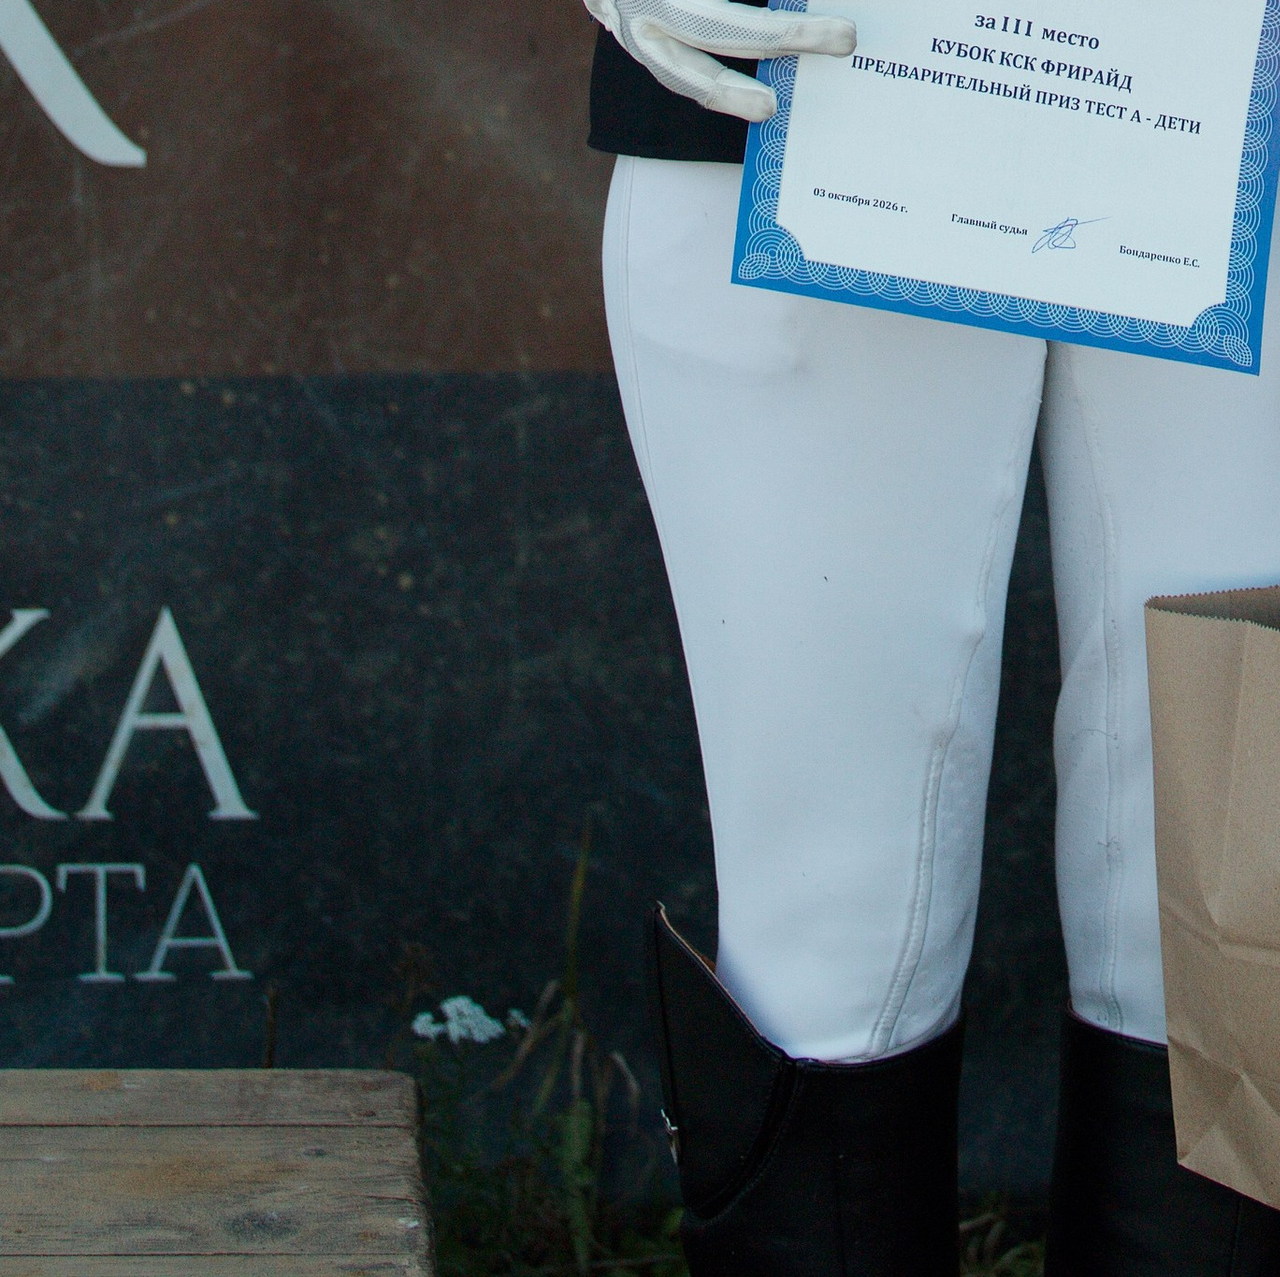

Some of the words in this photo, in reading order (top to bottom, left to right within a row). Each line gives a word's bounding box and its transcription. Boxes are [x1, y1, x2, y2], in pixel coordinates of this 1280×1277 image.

[974, 14, 996, 30] за
[1042, 27, 1100, 49] место
[930, 38, 997, 64] КУБОК
[999, 51, 1038, 72] КСК
[1041, 59, 1134, 94] ФРИРАЙД
[851, 55, 1032, 102] ПРЕДВАРИТЕЛЬНЫЙ
[1035, 90, 1081, 112] ПРИЗ
[1085, 99, 1128, 120] ТЕСТ
[1154, 114, 1202, 135] ДЕТИ
[813, 187, 826, 198] 03
[828, 192, 871, 207] октября
[872, 198, 899, 212] 2026
[900, 205, 909, 214] г.
[951, 213, 997, 231] Главный
[999, 223, 1029, 236] судья
[1119, 245, 1181, 265] Бондаренко
[1183, 257, 1201, 268] Е.С.
